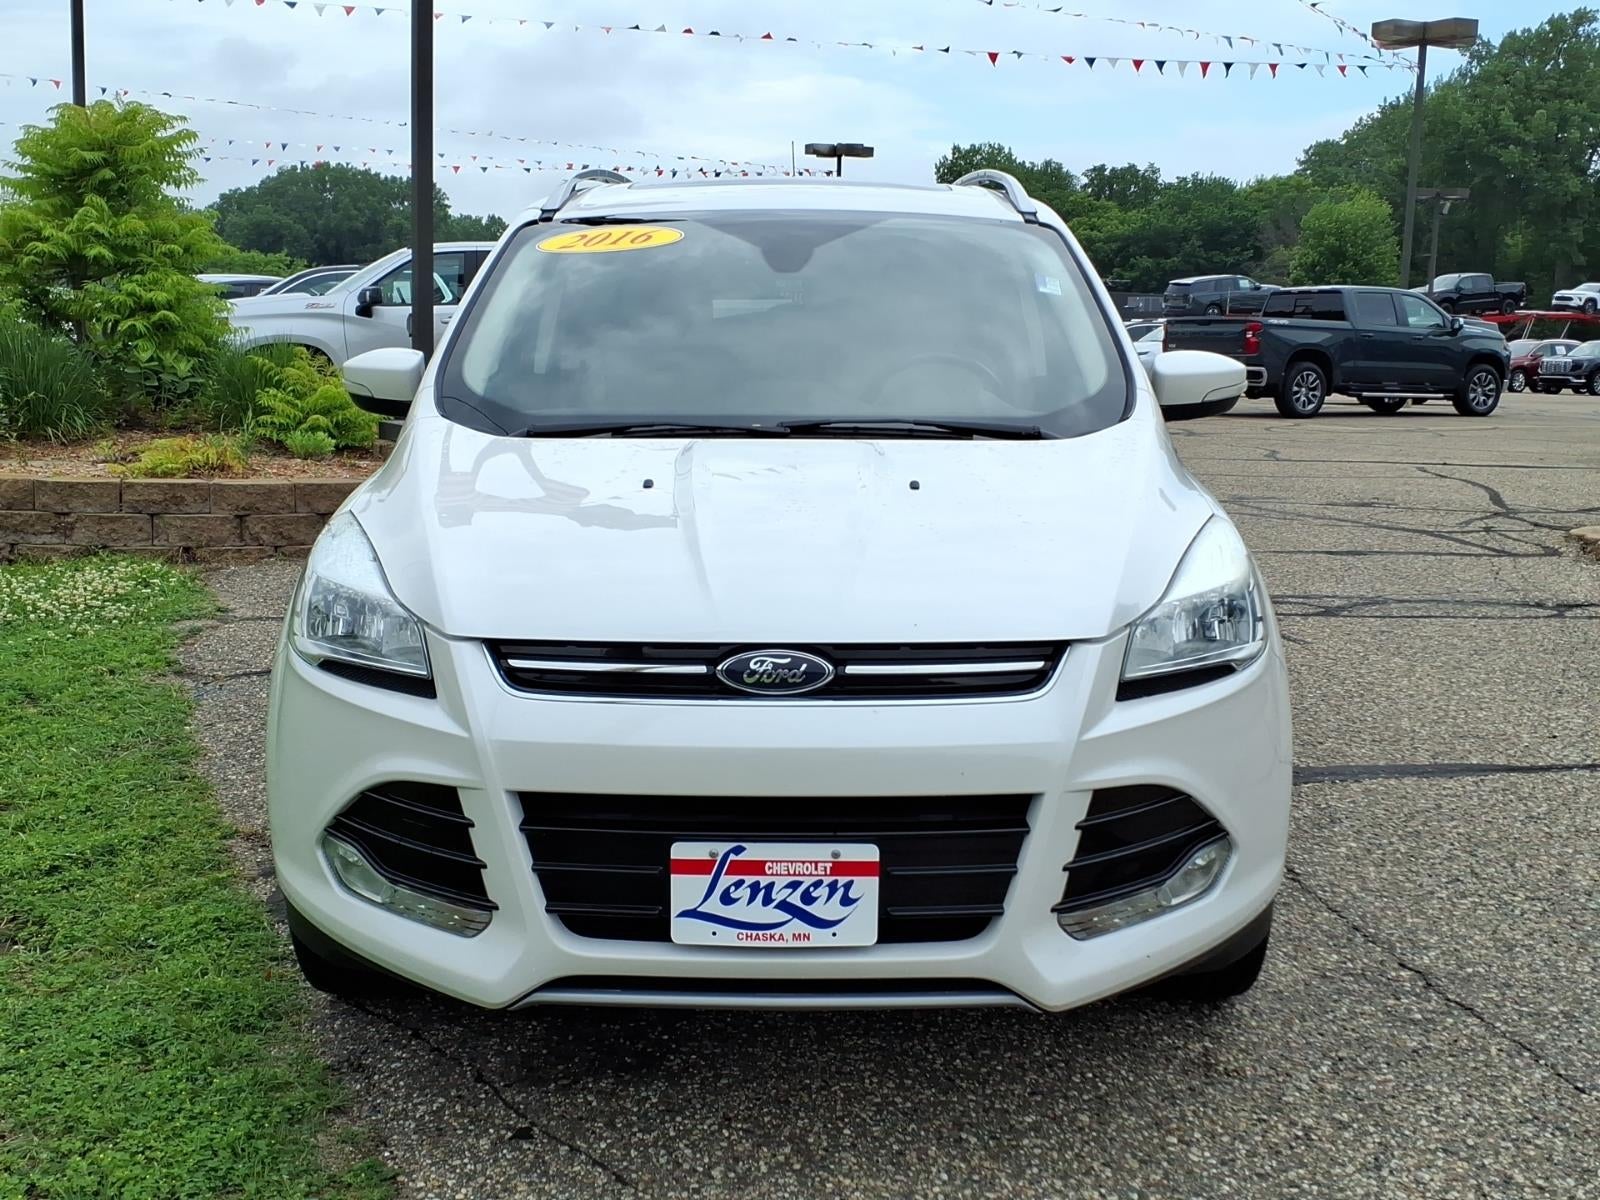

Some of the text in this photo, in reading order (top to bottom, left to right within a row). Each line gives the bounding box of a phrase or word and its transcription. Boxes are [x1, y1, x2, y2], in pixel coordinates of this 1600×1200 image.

[557, 229, 660, 250] 2016
[742, 656, 808, 684] Ford
[764, 862, 832, 875] CHEVROLET
[674, 844, 864, 932] Lenzen
[736, 932, 811, 943] CHASKA, MN
